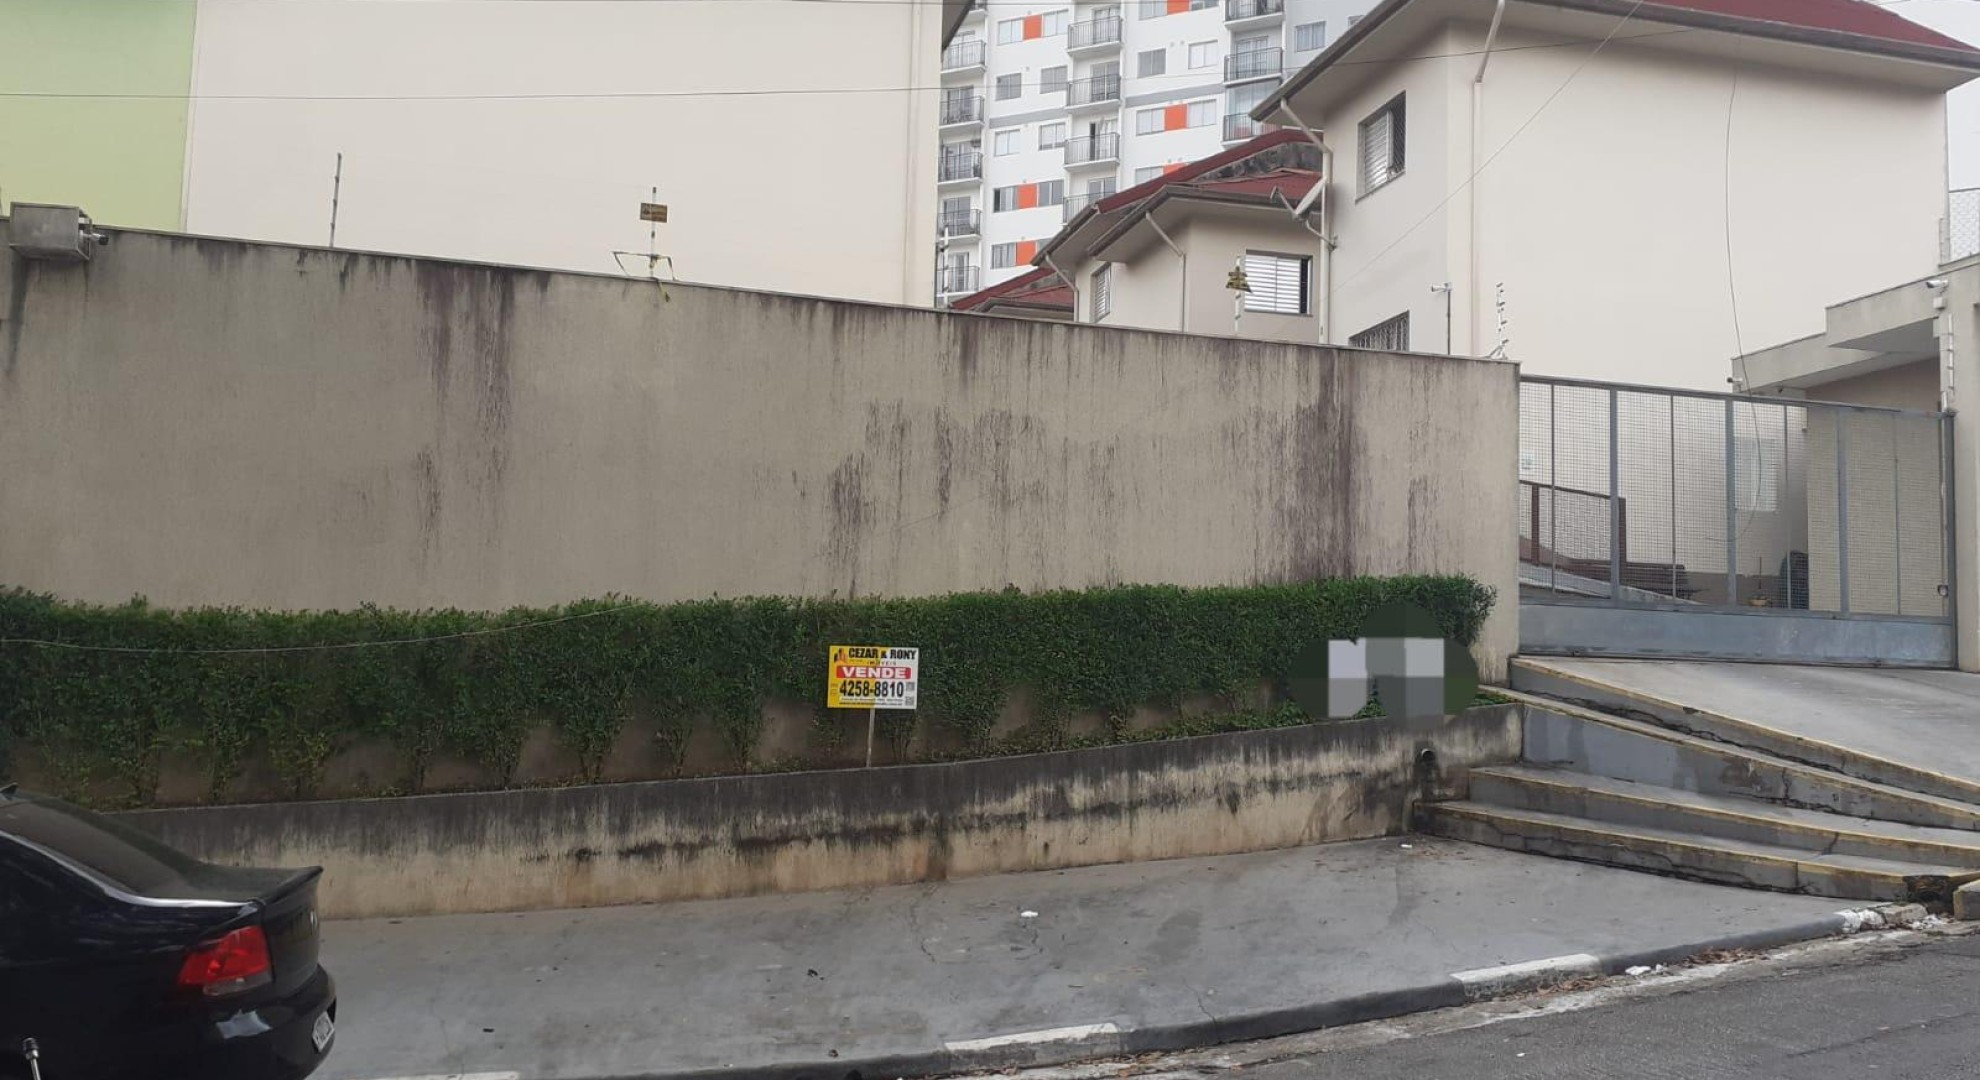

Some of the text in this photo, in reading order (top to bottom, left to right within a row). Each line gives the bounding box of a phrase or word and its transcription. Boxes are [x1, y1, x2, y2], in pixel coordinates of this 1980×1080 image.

[848, 647, 878, 659] CEZAR
[890, 649, 917, 660] RONY
[842, 666, 907, 679] VENDE
[839, 680, 904, 698] 4258-8810
